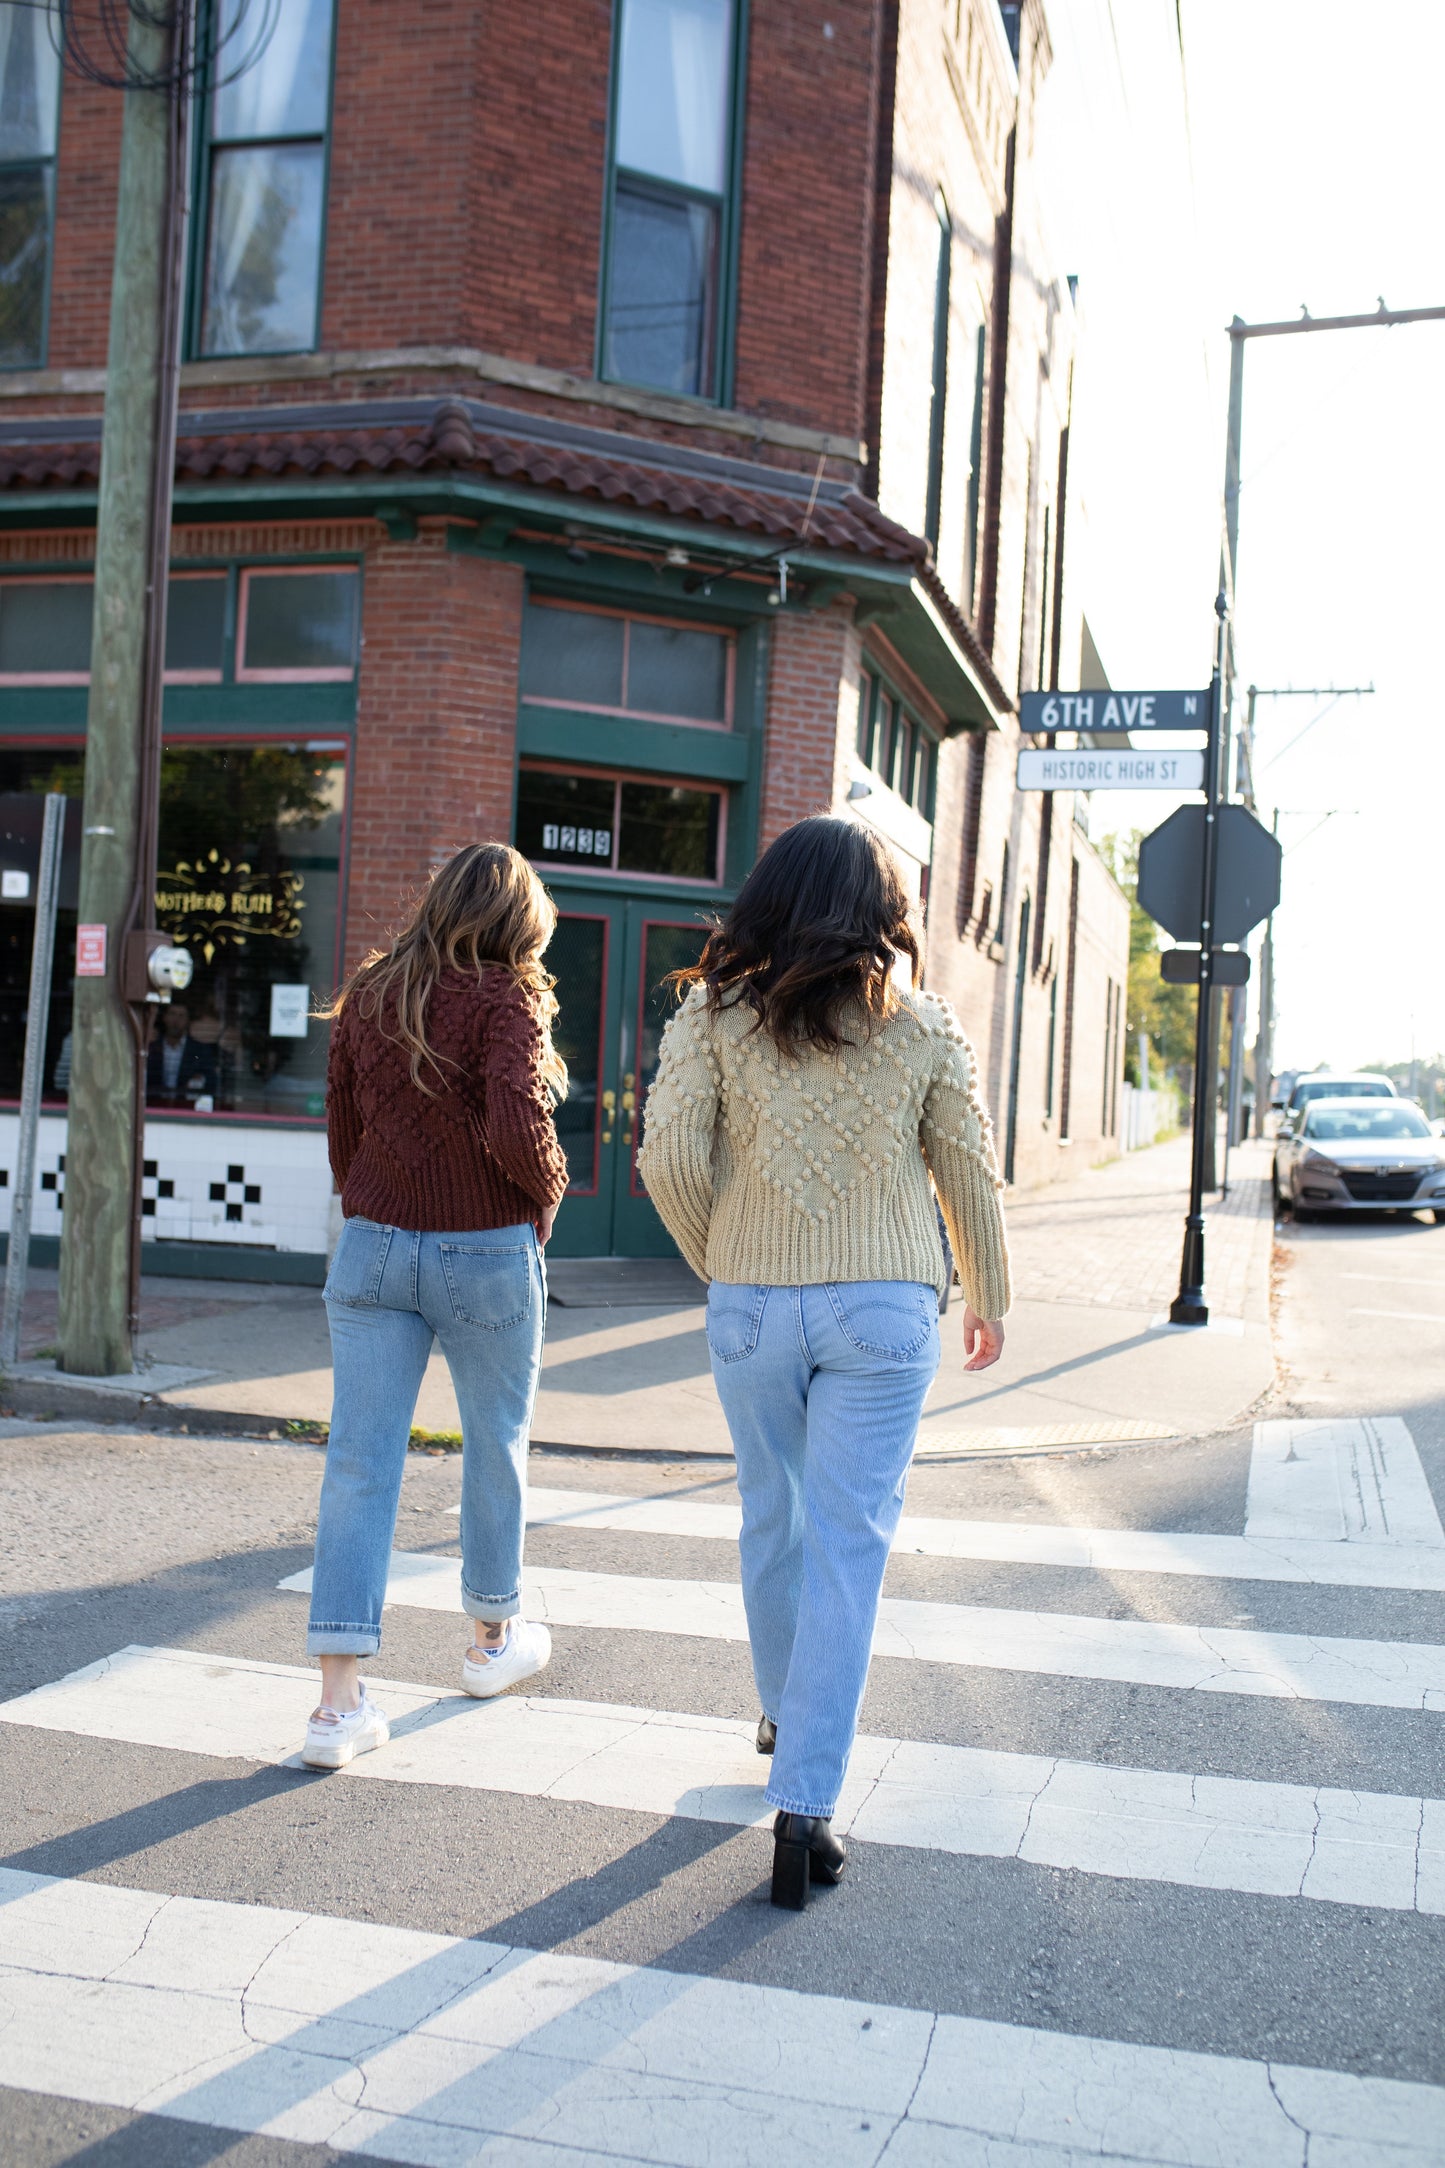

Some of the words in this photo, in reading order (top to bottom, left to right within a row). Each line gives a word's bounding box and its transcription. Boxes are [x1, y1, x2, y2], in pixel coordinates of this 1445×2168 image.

[1041, 697, 1094, 727] 6TH
[1101, 696, 1156, 726] AVE
[1184, 696, 1197, 715] N
[1042, 761, 1112, 780] HISTORIC
[1118, 761, 1155, 780] HIGH
[1160, 761, 1178, 780] ST
[543, 824, 610, 856] 1239
